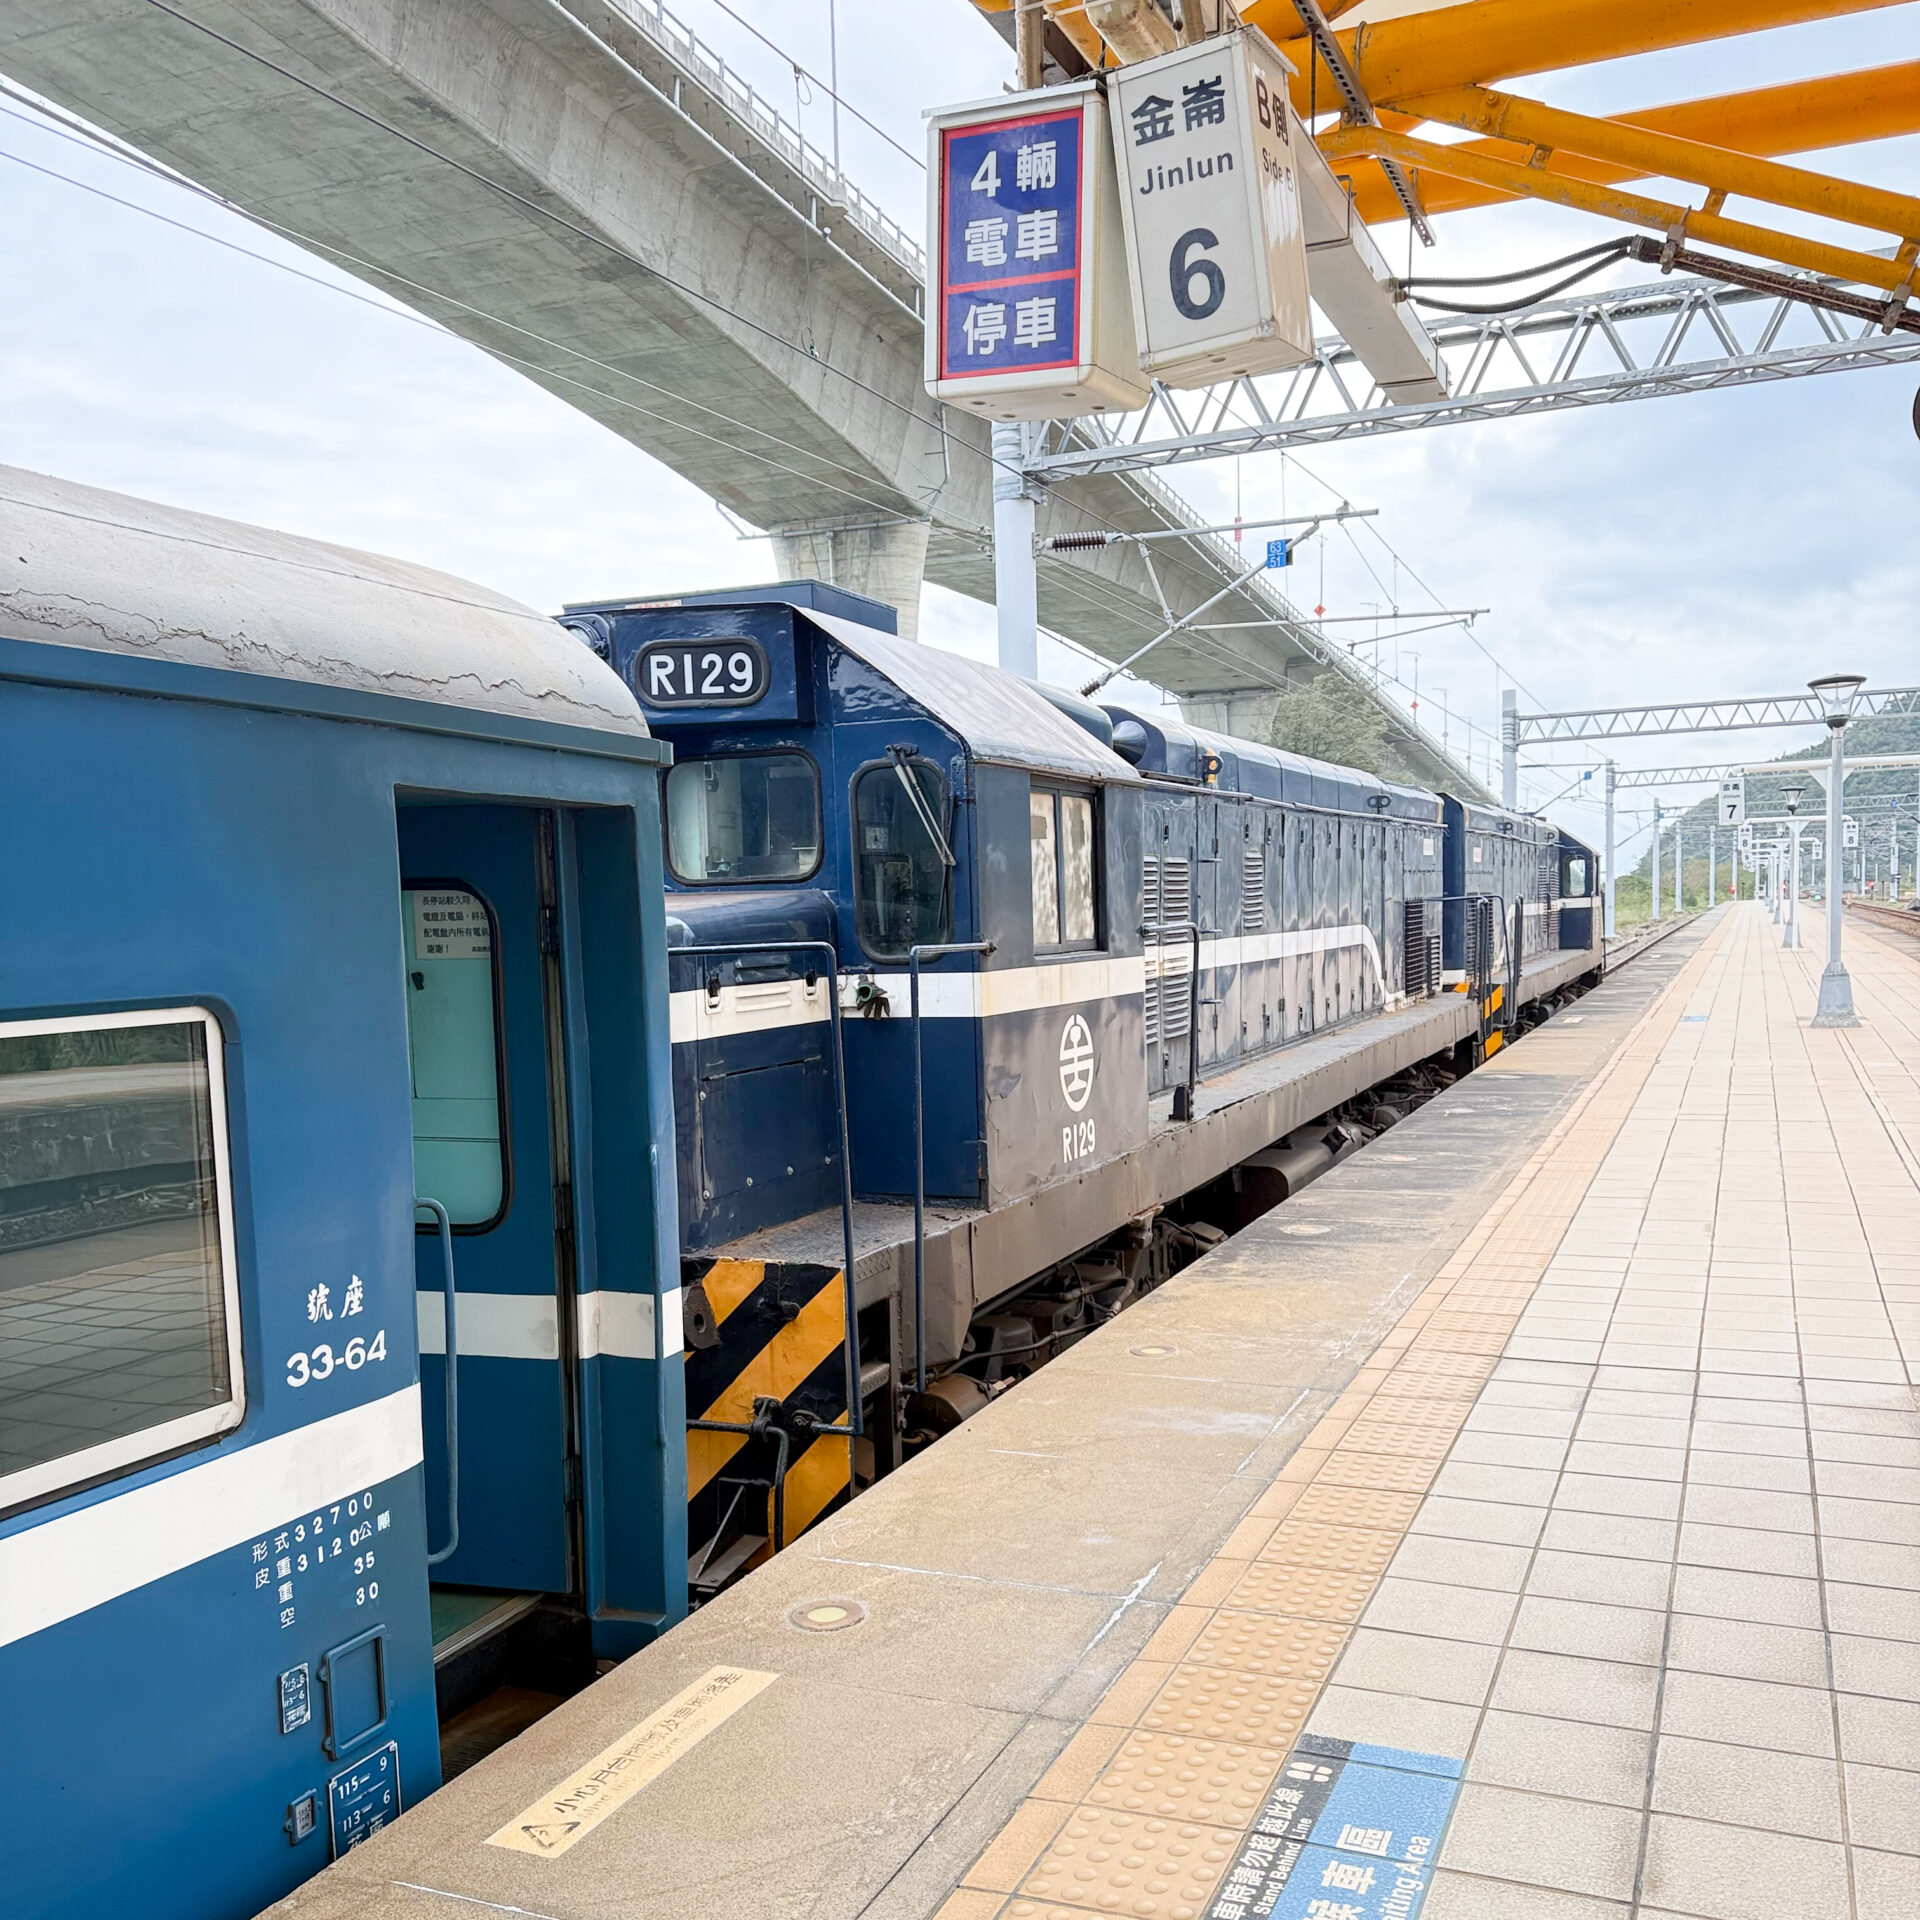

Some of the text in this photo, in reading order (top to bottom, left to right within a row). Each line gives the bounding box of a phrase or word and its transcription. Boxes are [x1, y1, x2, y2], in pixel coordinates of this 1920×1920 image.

[1131, 74, 1226, 147] 金崙
[1139, 150, 1234, 195] Jinlun
[1262, 147, 1294, 193] Side B
[964, 210, 1059, 268] 電車
[1169, 228, 1226, 320] 6
[962, 297, 1057, 356] 停車
[1269, 557, 1281, 568] 51
[1270, 542, 1282, 554] 63
[649, 651, 755, 696] R129
[1726, 804, 1737, 819] 7
[1742, 839, 1748, 847] 8
[1848, 836, 1854, 844] 8
[1062, 1118, 1096, 1164] R129
[286, 1330, 387, 1387] 33-64
[278, 1551, 375, 1604] 重 35
[280, 1582, 378, 1629] 空 30
[1253, 1818, 1313, 1914] Stand Behind Line
[1379, 1835, 1433, 1920] aiting Area
